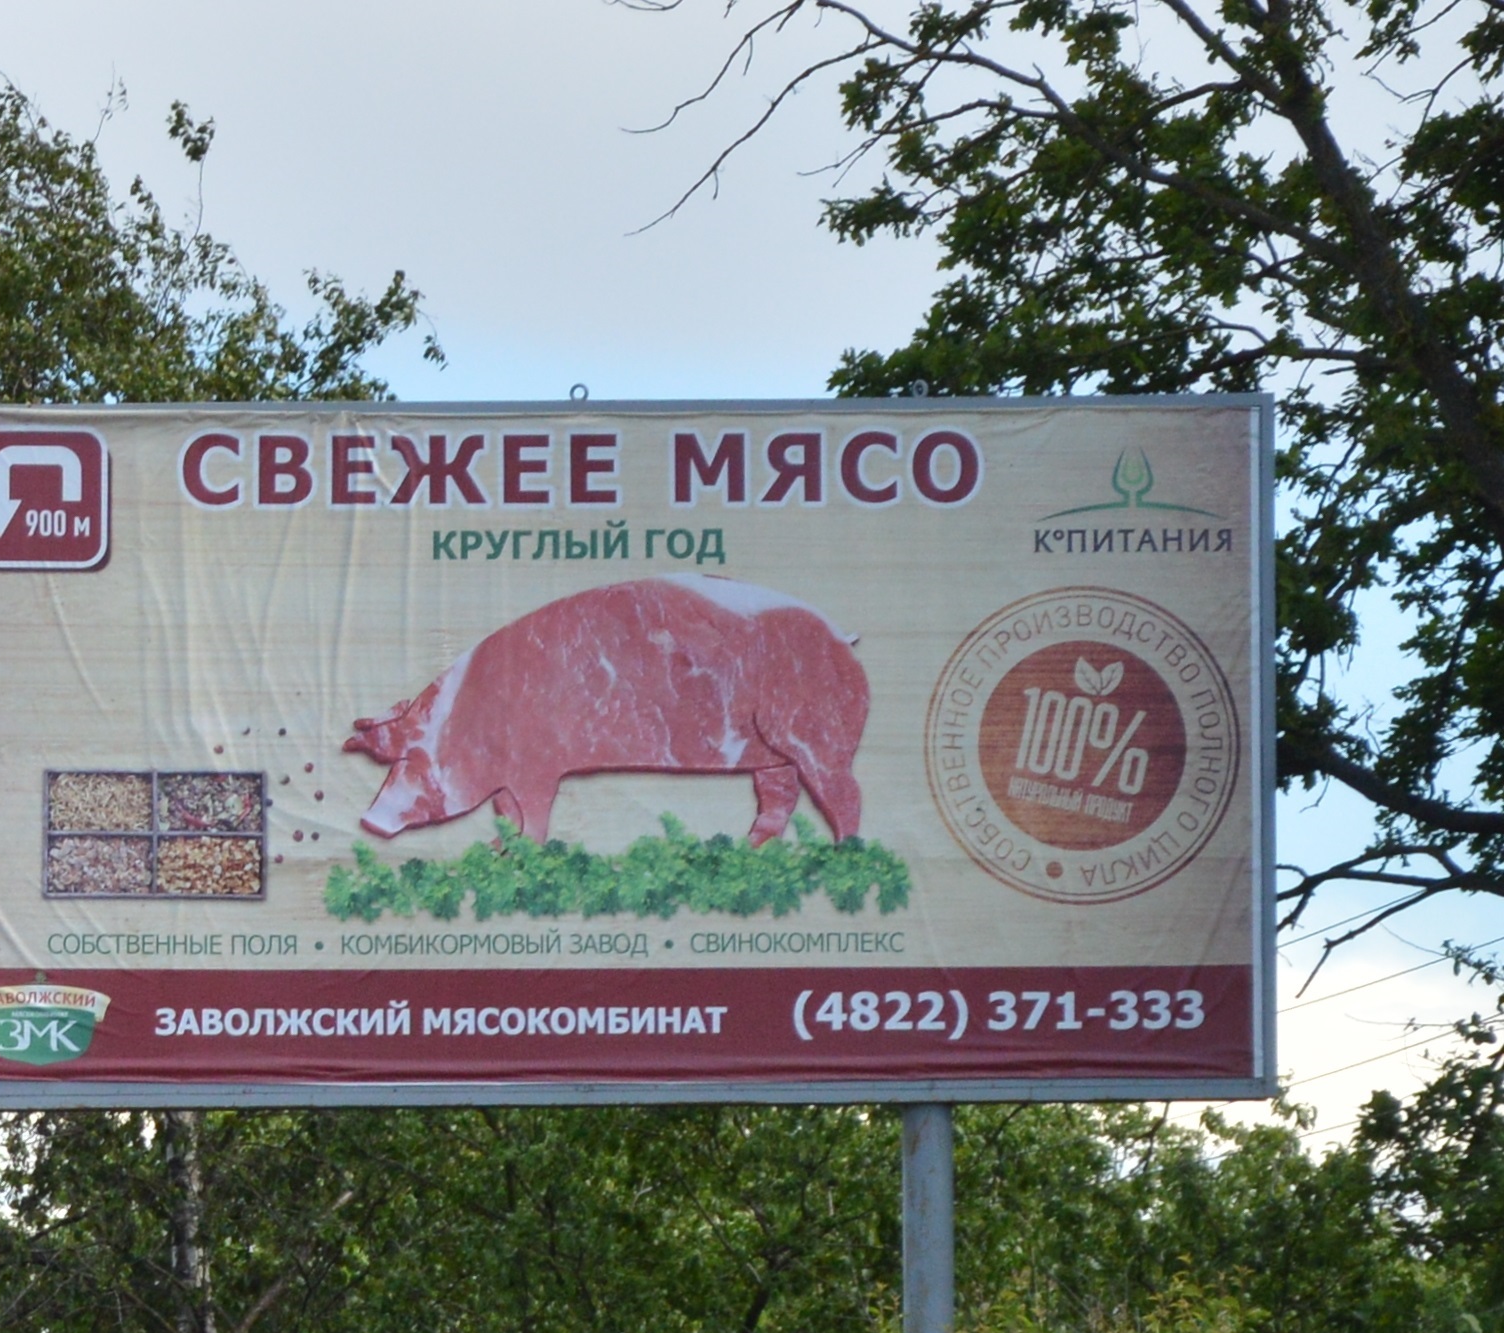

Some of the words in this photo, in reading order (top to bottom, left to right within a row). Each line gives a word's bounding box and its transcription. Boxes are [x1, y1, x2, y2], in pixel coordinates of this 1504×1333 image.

[182, 432, 617, 506] СВЕЖЕЕ
[674, 431, 980, 504] МЯСО
[25, 509, 66, 537] 900
[432, 520, 629, 560] КРУГЛЫЙ
[645, 528, 725, 565] ГОД
[976, 604, 1200, 683] ПРОИЗВОДСТВО
[1015, 686, 1149, 795] 100%
[1176, 689, 1224, 831] ПОЛНОГО
[942, 667, 1032, 872] СОБСТВЕННОЕ
[1080, 831, 1180, 886] ЦИКЛА
[48, 933, 222, 956] СОБСТВЕННЫЕ
[231, 934, 298, 956] ПОЛЯ
[341, 928, 561, 956] КОМБИКОРМОВЫЙ
[570, 933, 648, 957] ЗАВОД
[691, 931, 904, 954] СВИНОКОМПЛЕКС
[155, 1000, 410, 1036] ЗАВОЛЖСКИЙ
[424, 1006, 727, 1036] МЯСОКОМБИНАТ
[793, 990, 969, 1040] (4822)
[988, 990, 1205, 1031] 371-333
